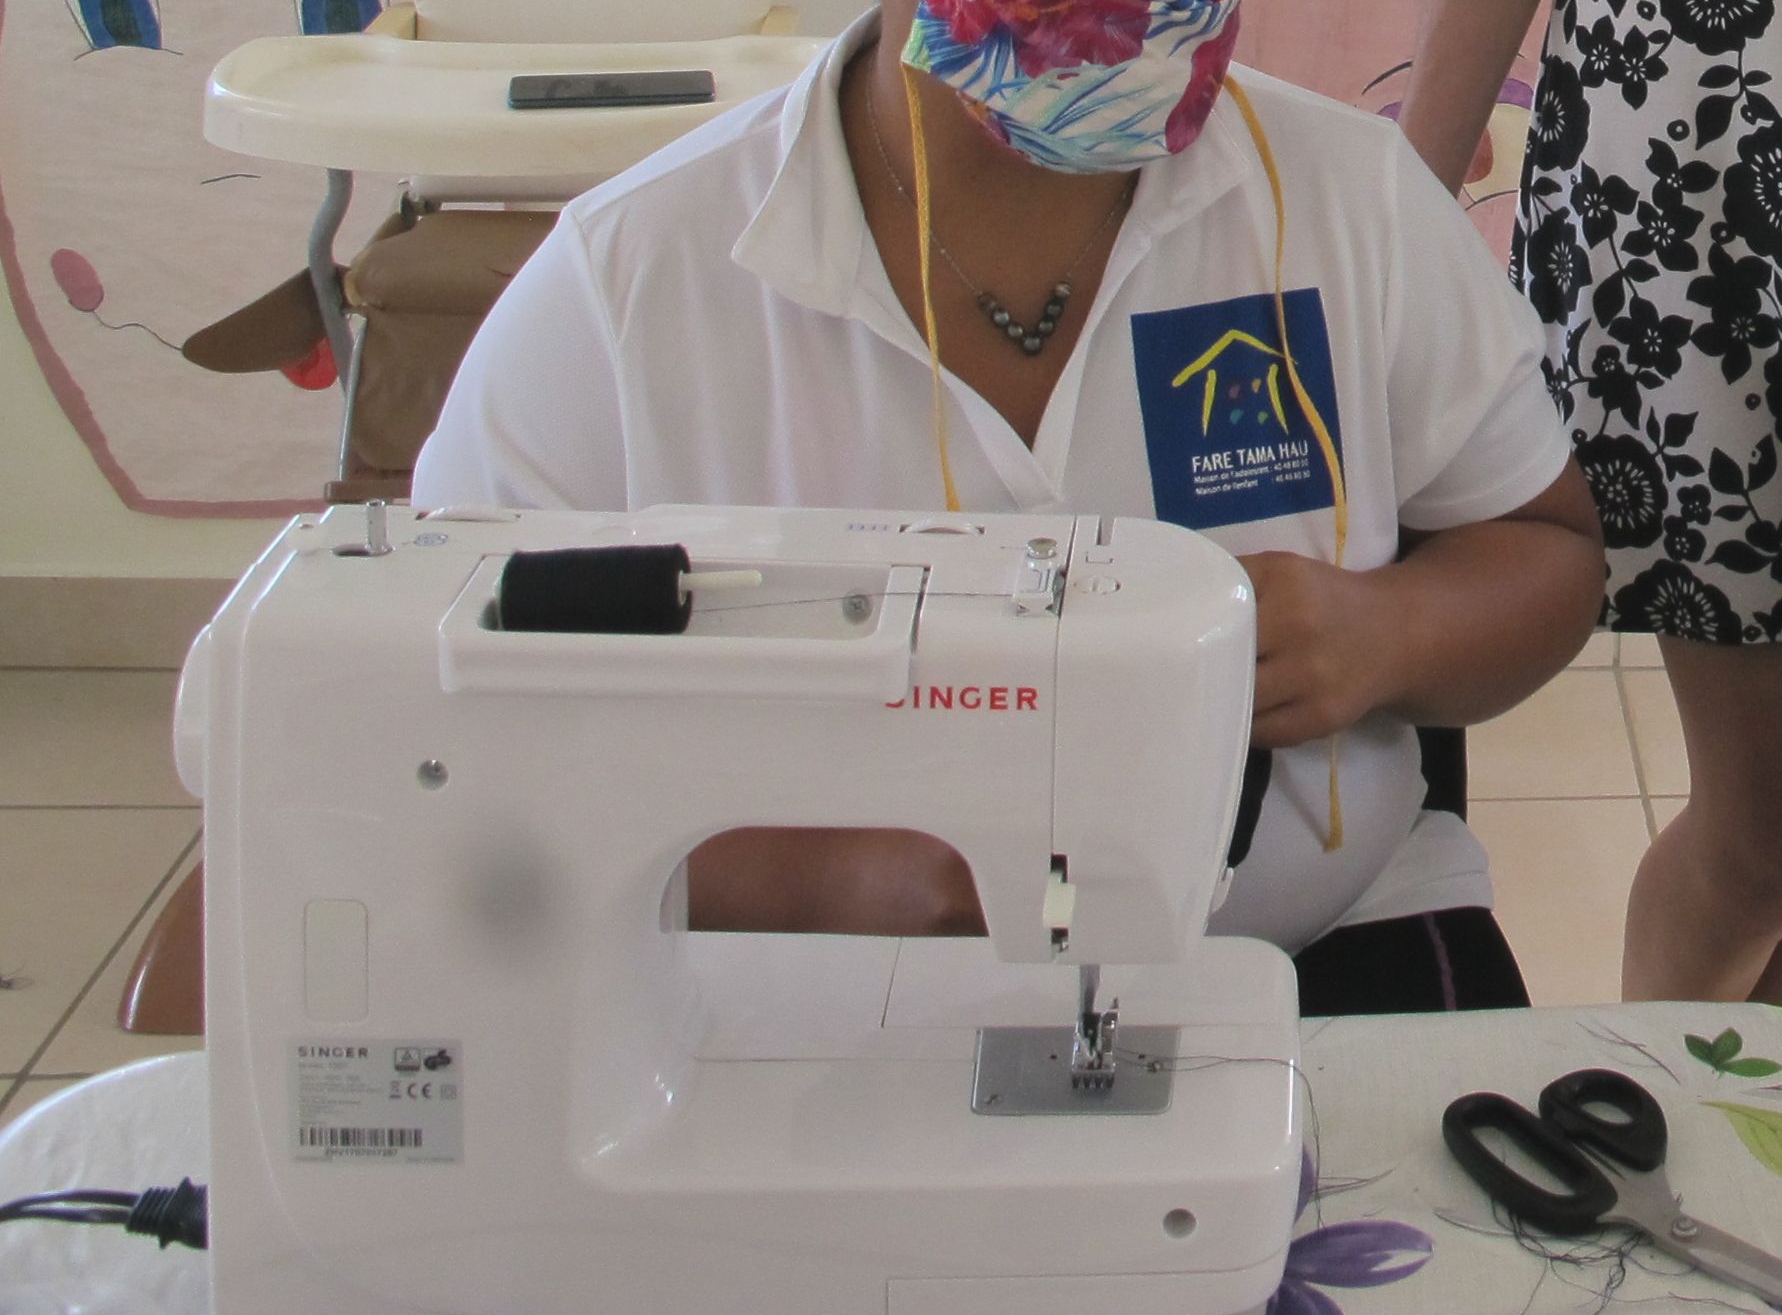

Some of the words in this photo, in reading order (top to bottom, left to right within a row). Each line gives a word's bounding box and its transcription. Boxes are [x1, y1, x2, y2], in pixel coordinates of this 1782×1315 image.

[1192, 451, 1233, 473] FARE
[1236, 445, 1276, 465] TAMA
[1278, 439, 1309, 460] HAU
[298, 1046, 368, 1058] SINGER
